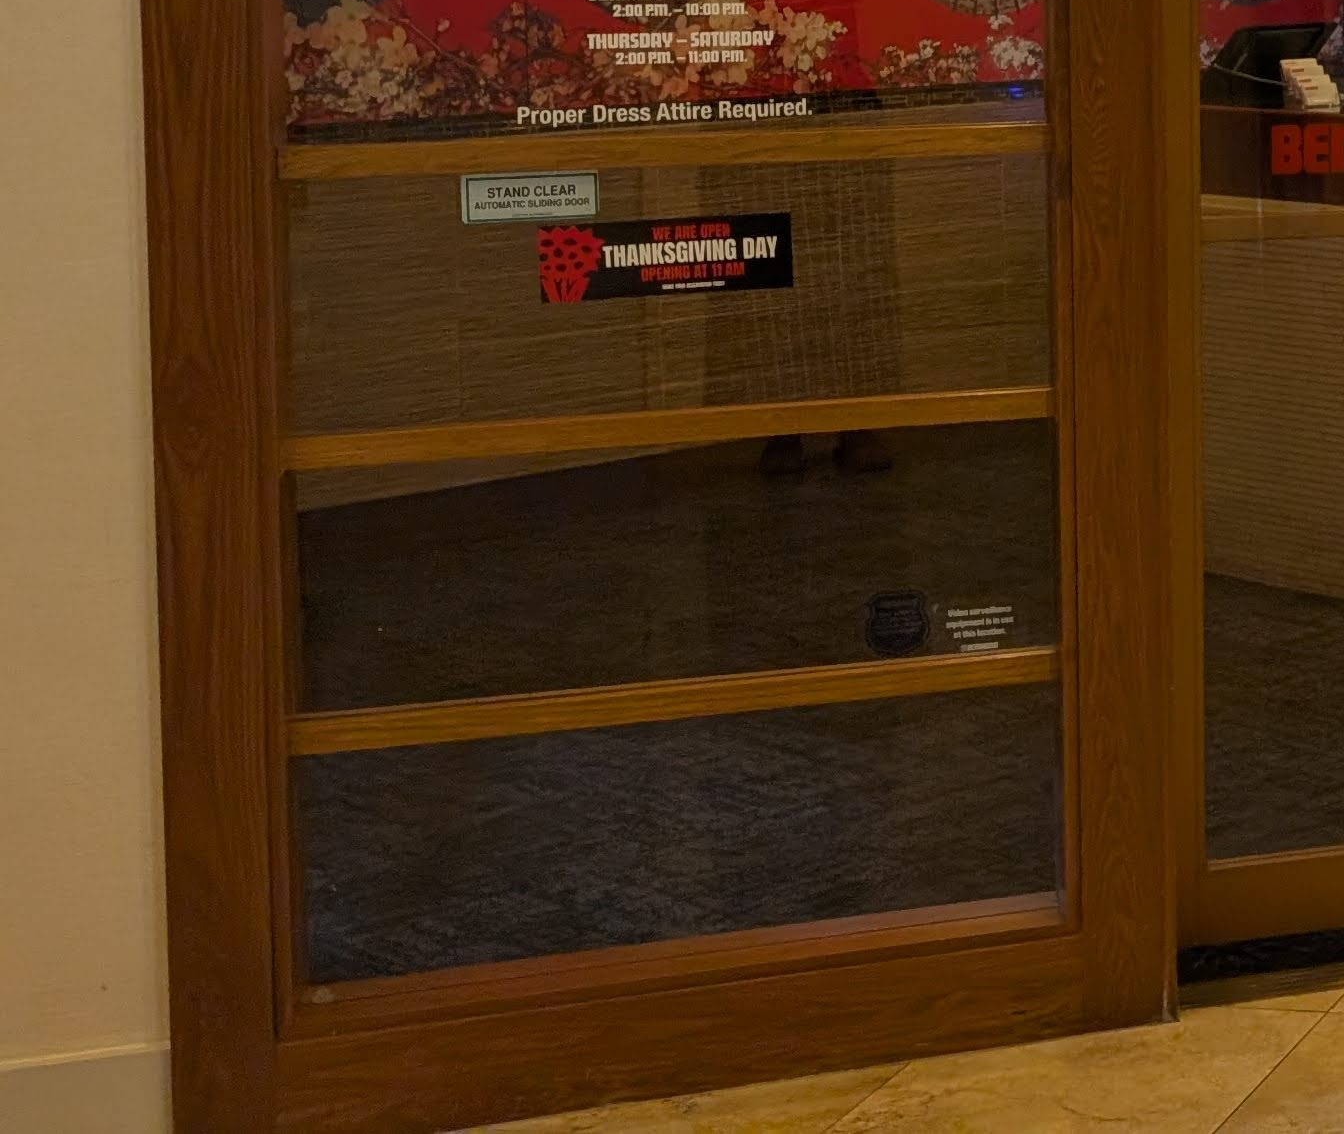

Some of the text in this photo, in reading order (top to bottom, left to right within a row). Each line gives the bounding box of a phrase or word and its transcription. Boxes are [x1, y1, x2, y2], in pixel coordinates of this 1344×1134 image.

[612, 4, 643, 17] 2:00
[685, 2, 720, 16] 10:00
[586, 32, 673, 49] THURSDAY
[690, 29, 775, 47] SATURDAY
[615, 52, 646, 65] 2:00
[688, 50, 720, 63] 11:00
[516, 97, 813, 128] Proper Dress Attire Required.
[487, 183, 577, 199] STAND CLEAR
[474, 197, 590, 210] AUTOMATIC SLIDING DOOR
[652, 223, 731, 241] WE ARE OPEN
[602, 235, 778, 268] THANKSGIVING DAY
[640, 264, 691, 282] OPENING
[694, 264, 710, 279] AT
[724, 261, 745, 277] AM
